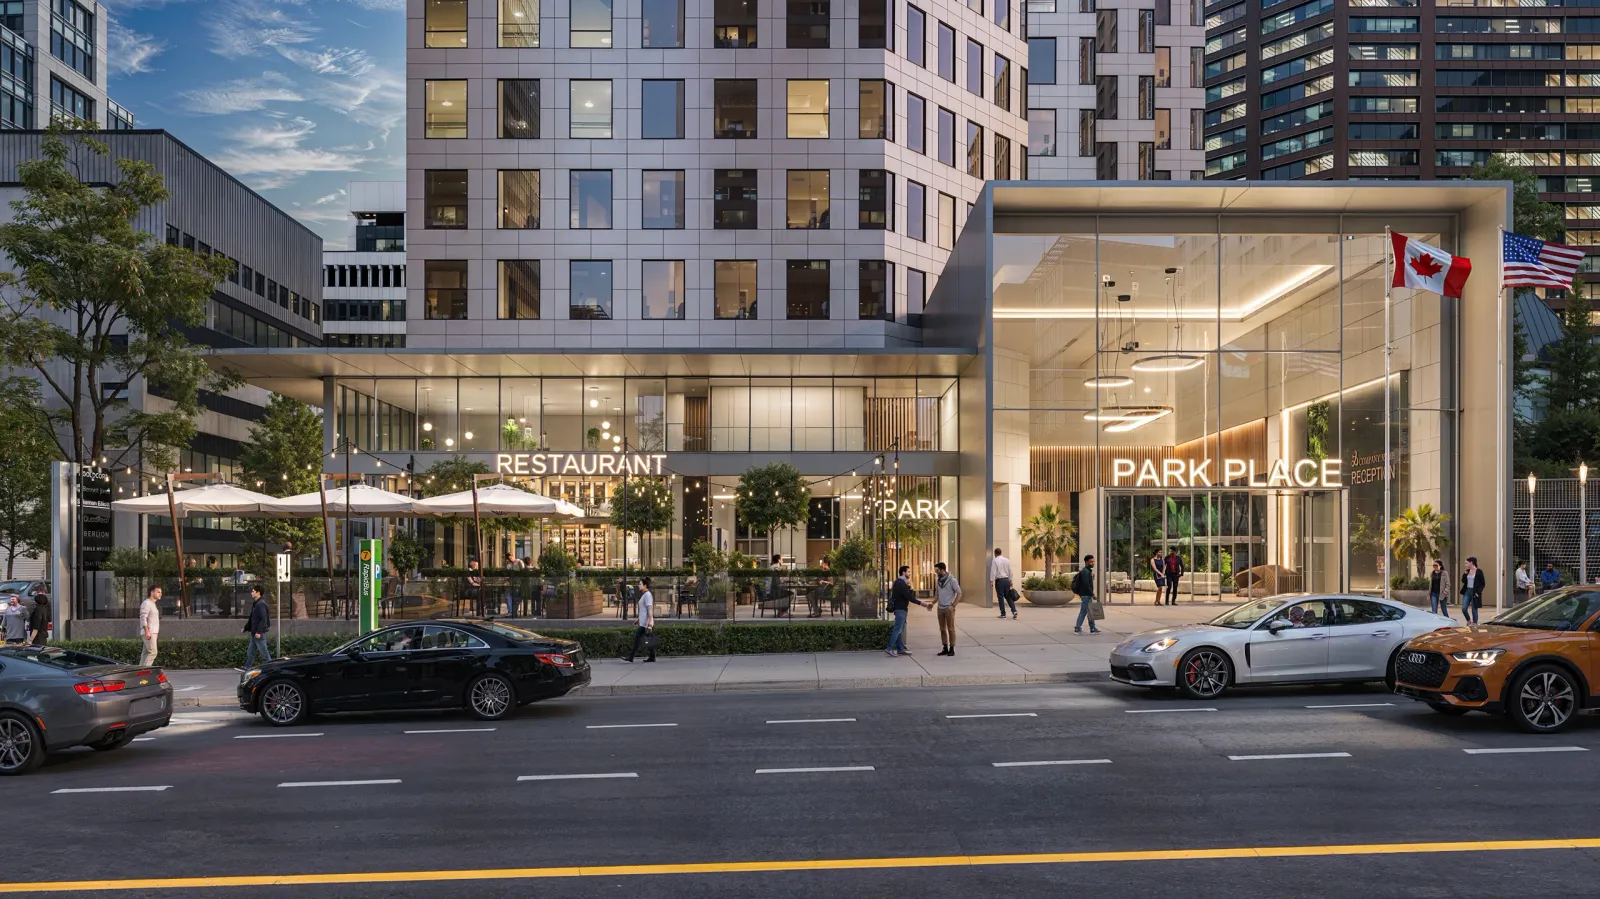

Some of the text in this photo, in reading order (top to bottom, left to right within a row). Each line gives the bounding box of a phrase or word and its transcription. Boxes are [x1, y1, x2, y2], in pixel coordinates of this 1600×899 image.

[497, 454, 667, 474] RESTAURANT
[1113, 458, 1343, 487] PARK PLACE
[1352, 464, 1396, 485] RECEPTIN
[99, 487, 110, 495] Jon
[883, 499, 951, 520] PARK
[363, 552, 368, 560] 7
[362, 563, 370, 596] RapidBus
